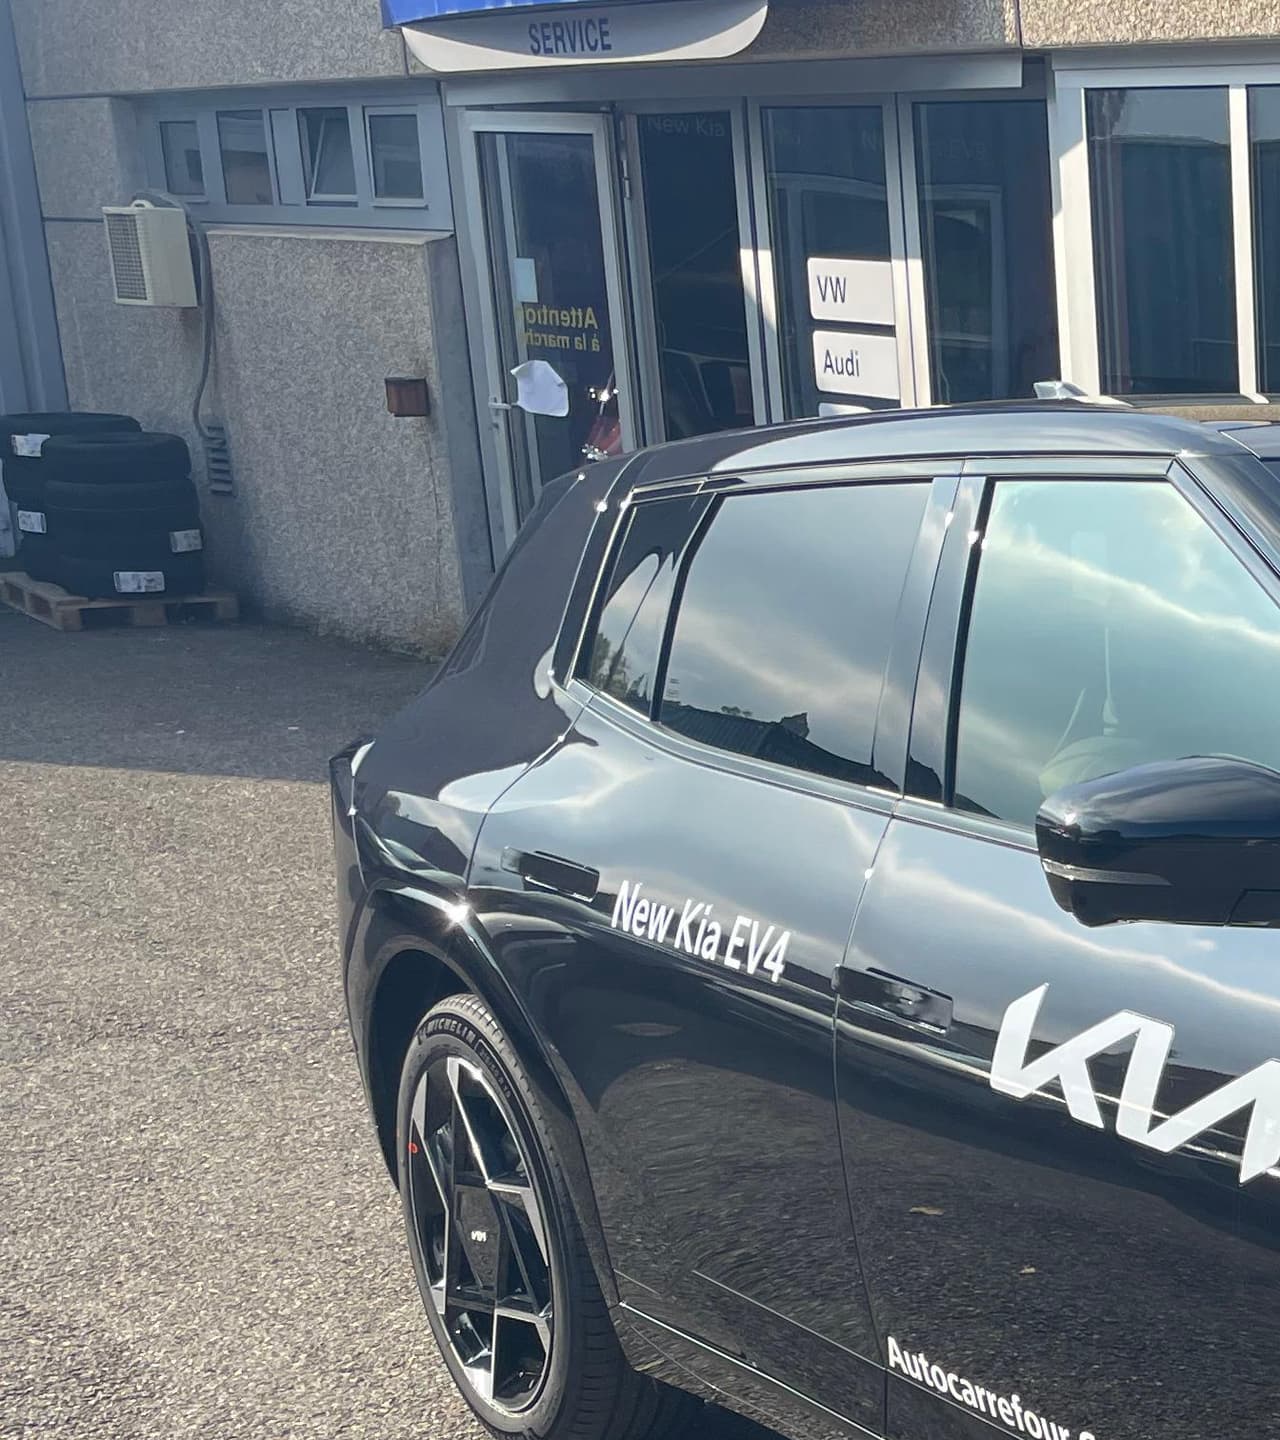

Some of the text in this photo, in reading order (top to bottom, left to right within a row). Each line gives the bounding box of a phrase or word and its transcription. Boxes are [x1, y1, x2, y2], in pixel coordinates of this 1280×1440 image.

[528, 18, 612, 55] SERVICE
[816, 274, 847, 303] VW
[823, 348, 860, 376] Audi
[610, 879, 792, 983] New Kia EV4
[426, 1018, 477, 1043] MICHELIN
